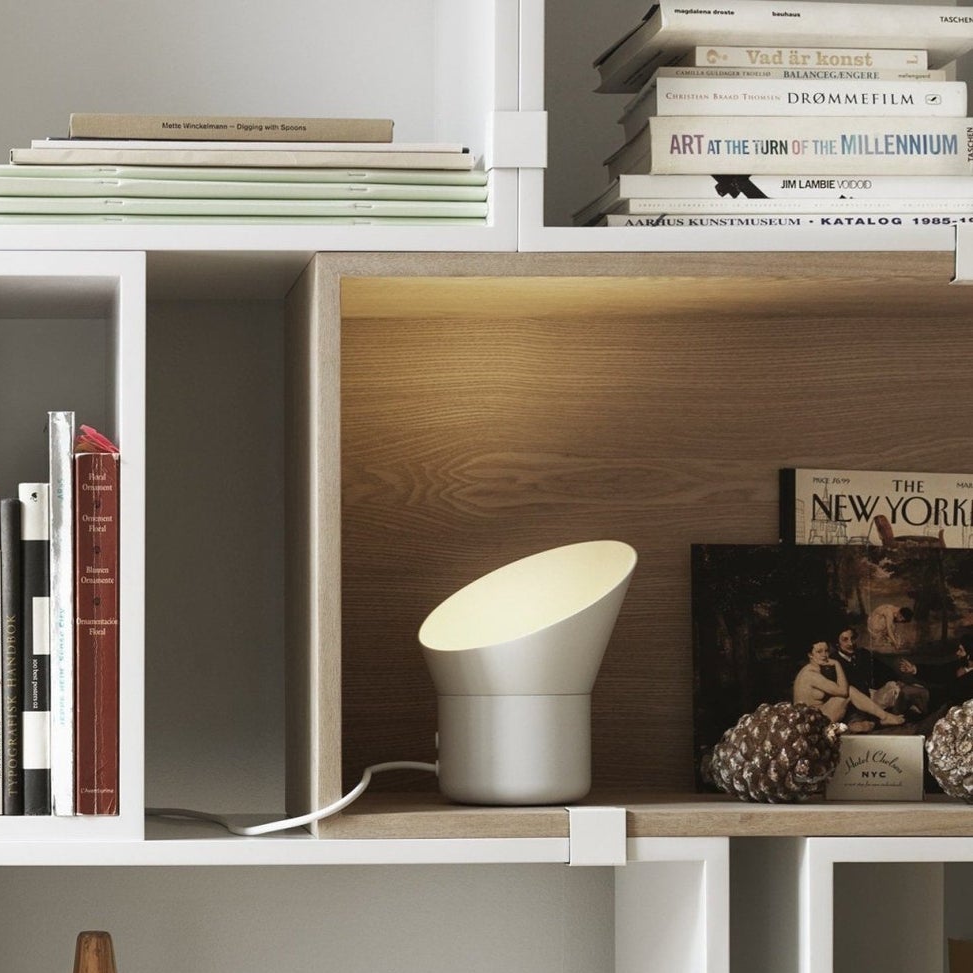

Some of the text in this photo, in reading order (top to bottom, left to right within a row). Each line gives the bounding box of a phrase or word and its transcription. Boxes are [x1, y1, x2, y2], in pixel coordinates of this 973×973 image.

[746, 50, 873, 66] Vad är konst
[788, 92, 914, 105] DRØMMEFILM
[183, 122, 228, 130] Winckelmann
[236, 123, 262, 132] Digging
[280, 124, 306, 132] Spoons
[670, 134, 958, 155] ART AT THE TURN OF THE MILLENNIUM
[781, 180, 836, 189] JIM LAMBIE
[689, 218, 902, 226] KUNSTMUSEUM KATALOG
[89, 472, 106, 481] Floral
[82, 484, 112, 492] Ornament
[892, 480, 924, 493] THE
[812, 493, 880, 522] NEW
[82, 514, 112, 522] Ornement
[86, 566, 110, 574] Blumen
[81, 576, 114, 584] Ornamente
[89, 628, 106, 636] Floral
[6, 614, 18, 797] TYPOGRAFISK HANDBOK
